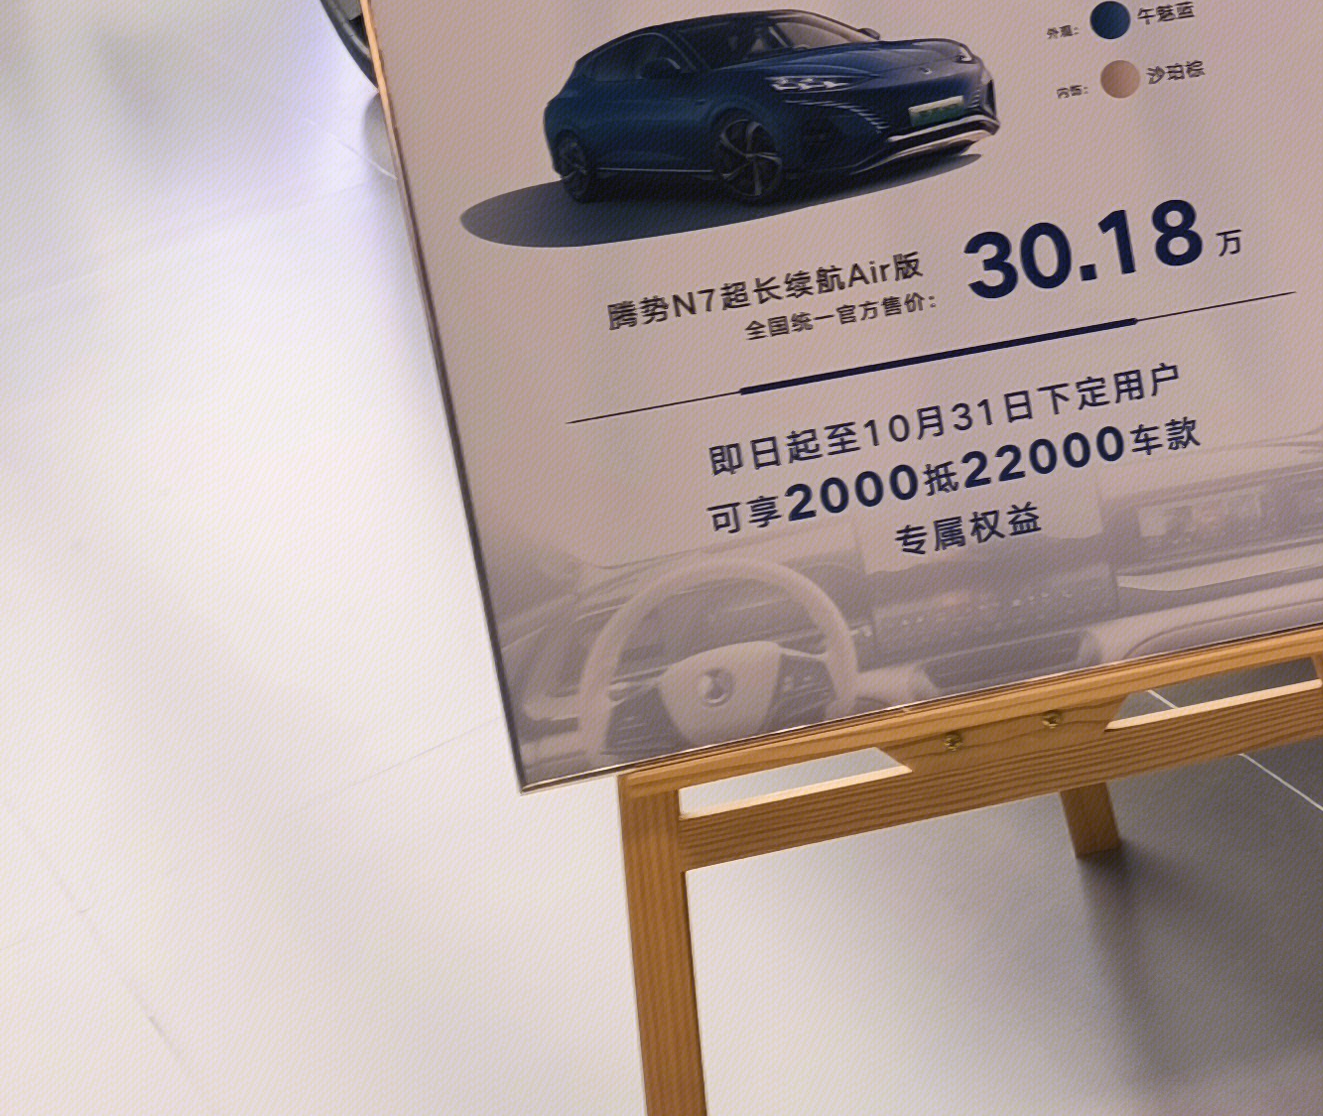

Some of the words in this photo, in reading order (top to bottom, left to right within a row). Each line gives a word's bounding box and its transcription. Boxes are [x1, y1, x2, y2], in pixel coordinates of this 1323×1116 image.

[1137, 1, 1196, 25] 午魅蓝
[606, 250, 925, 332] 腾势N7超长续航Air版
[963, 199, 1203, 299] 30.18
[1217, 228, 1244, 258] 万
[708, 362, 1181, 477] 即日起至10月31日下定用户
[706, 415, 1202, 536] 可享2000抵22000车款
[894, 501, 1042, 555] 专属权益
